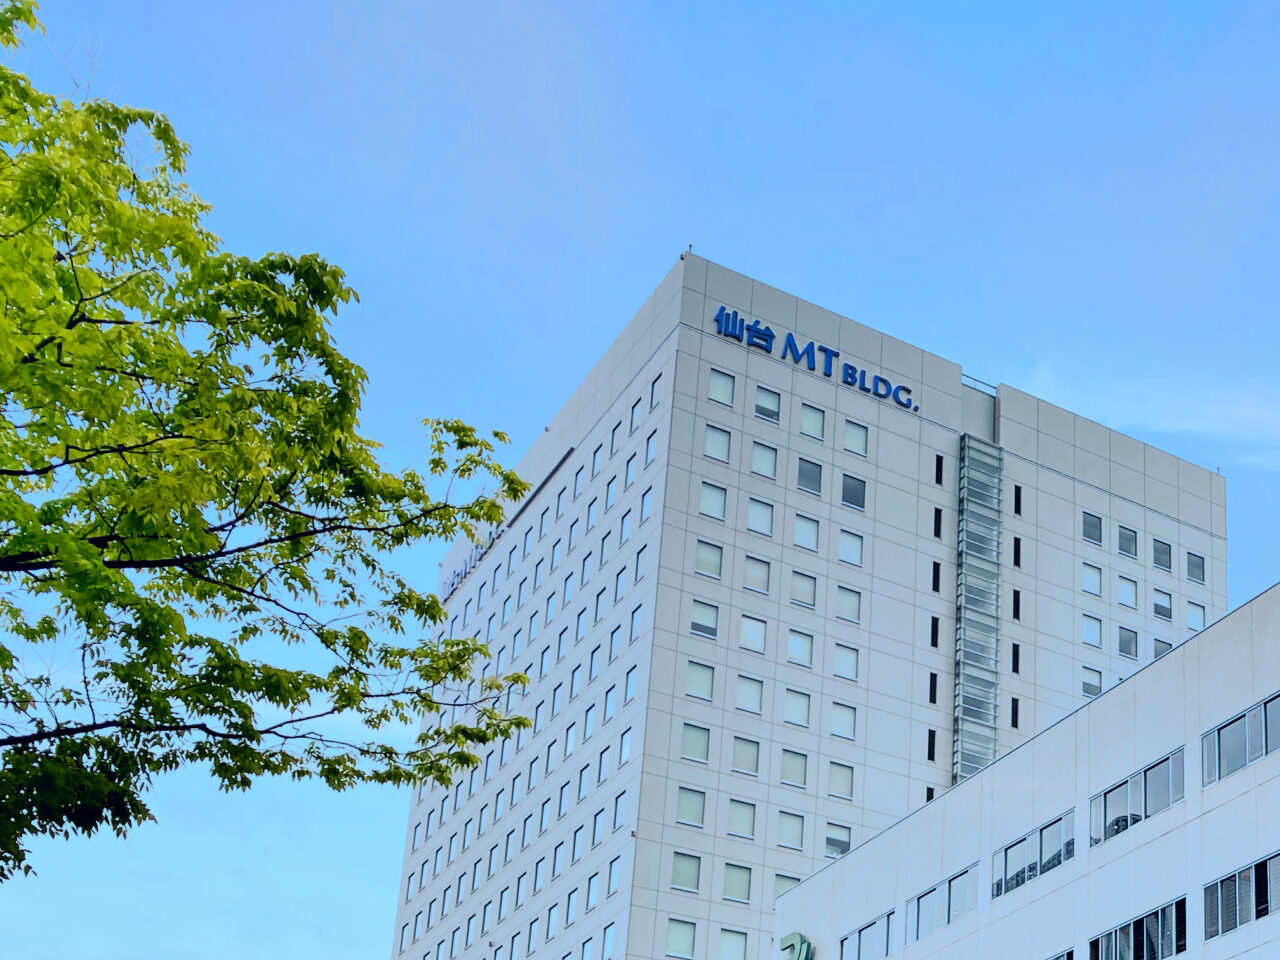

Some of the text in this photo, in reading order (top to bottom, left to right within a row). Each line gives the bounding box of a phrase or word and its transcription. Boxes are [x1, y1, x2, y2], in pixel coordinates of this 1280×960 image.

[714, 305, 920, 412] 仙台 MT BLDG.
